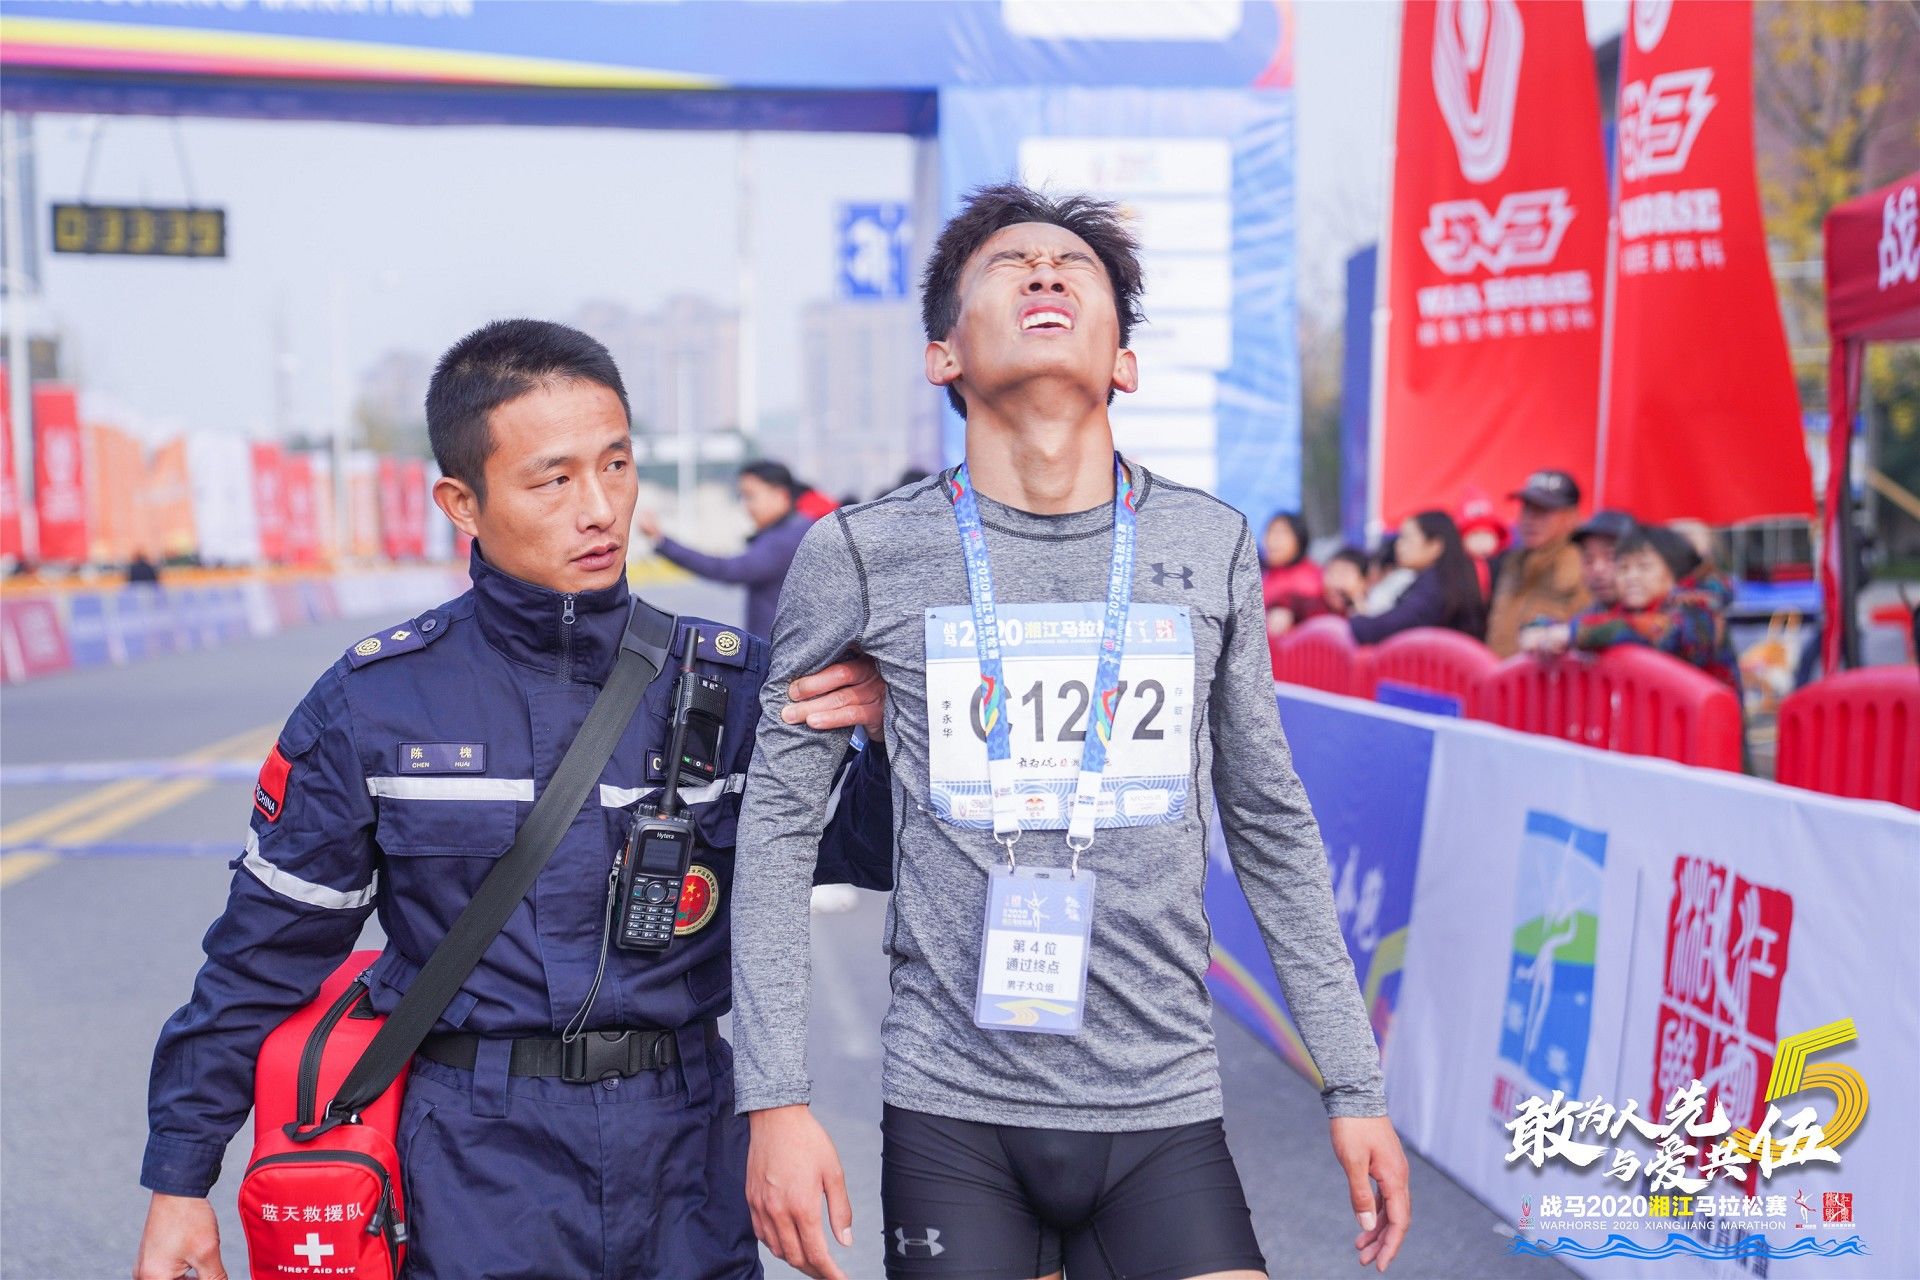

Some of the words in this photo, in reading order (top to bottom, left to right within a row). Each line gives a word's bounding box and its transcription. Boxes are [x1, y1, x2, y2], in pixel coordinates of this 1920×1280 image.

[656, 832, 675, 840] Hytera
[1013, 939, 1025, 953] 第
[1030, 941, 1039, 954] 4
[1045, 942, 1057, 955] 位
[1006, 957, 1059, 974] 通过终点
[261, 1203, 365, 1222] 蓝天救援队
[278, 1265, 309, 1274] FIRST
[313, 1266, 333, 1274] AID
[336, 1266, 356, 1274] KIT
